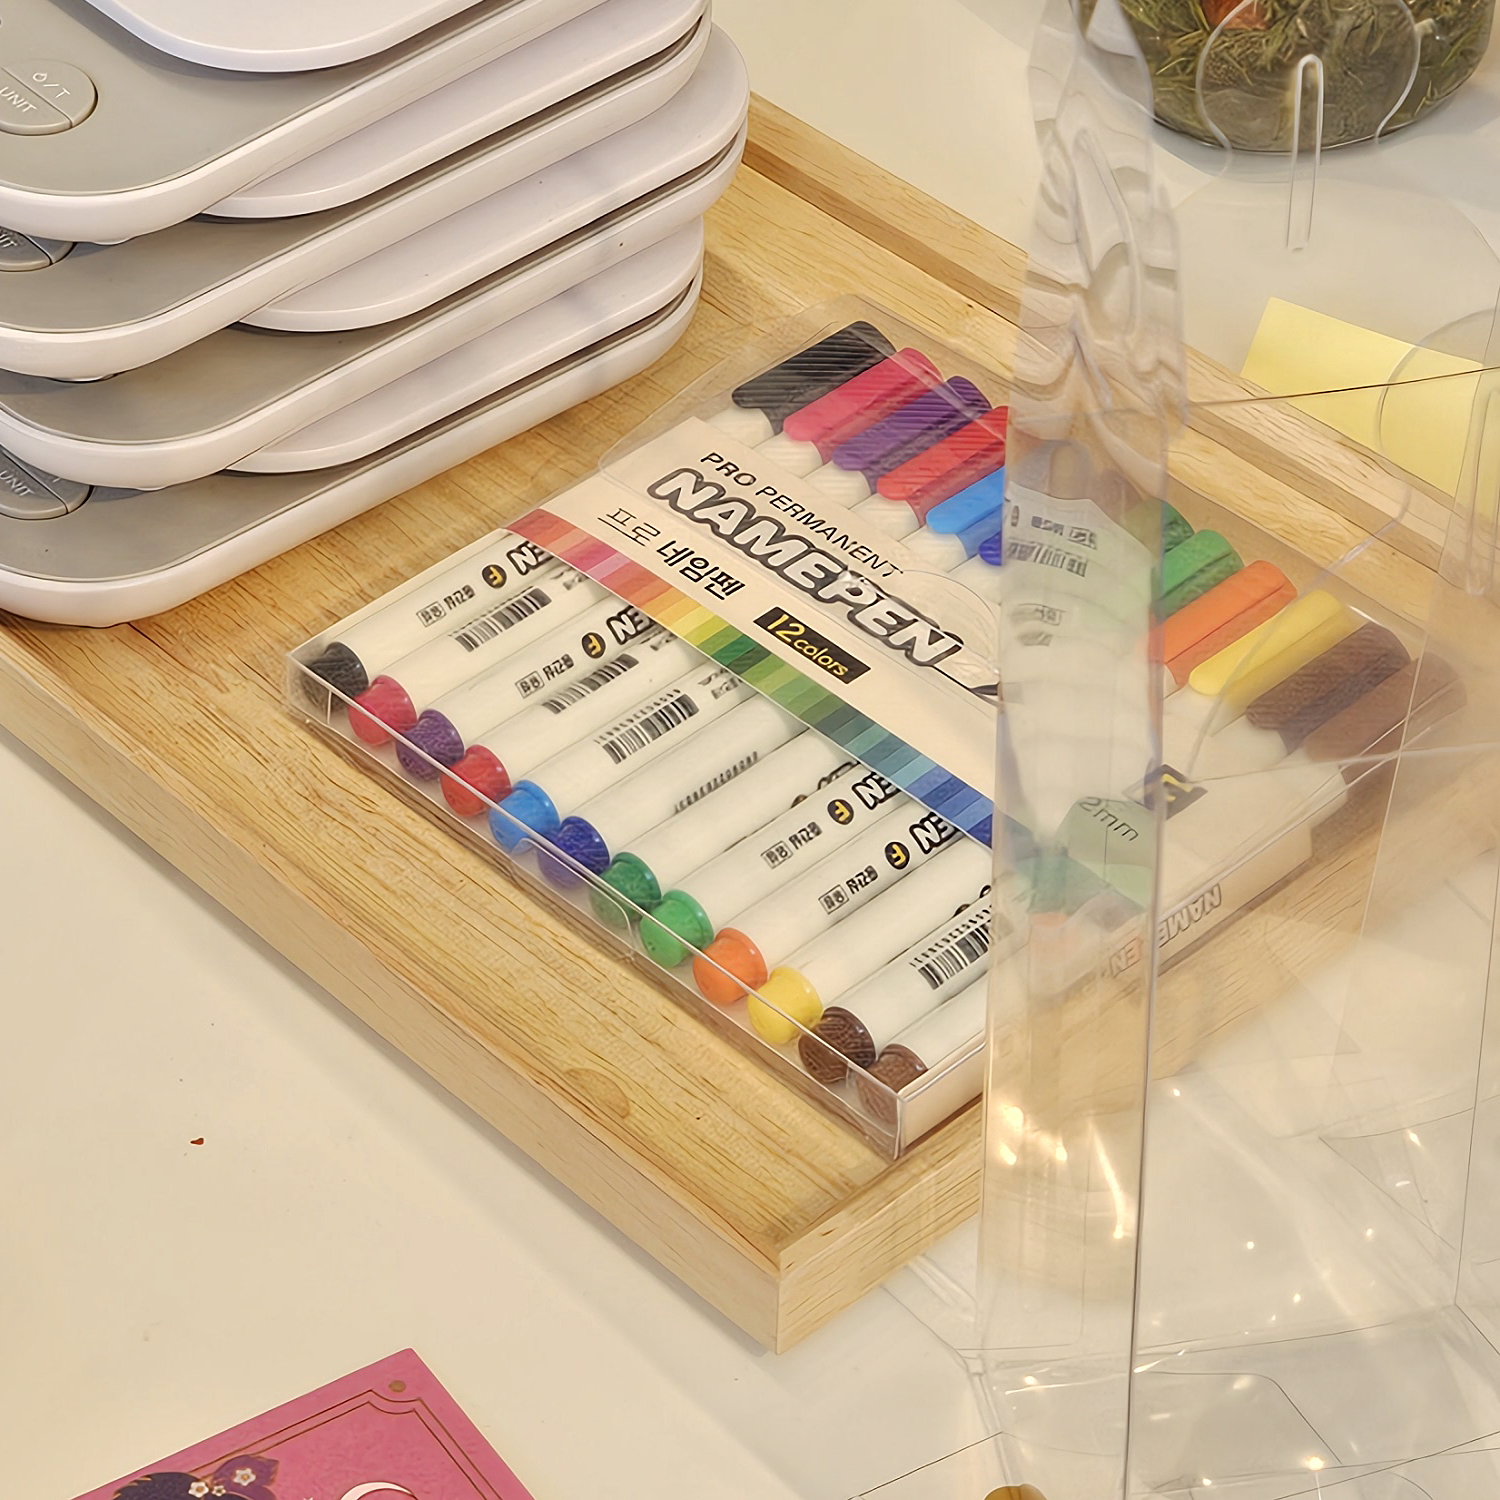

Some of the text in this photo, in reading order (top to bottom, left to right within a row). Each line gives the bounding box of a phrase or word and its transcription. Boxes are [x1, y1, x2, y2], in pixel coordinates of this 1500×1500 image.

[598, 507, 747, 601] 프로 네임펜
[647, 467, 965, 668] NAMEPEN
[700, 452, 904, 579] PRO PERMANENT
